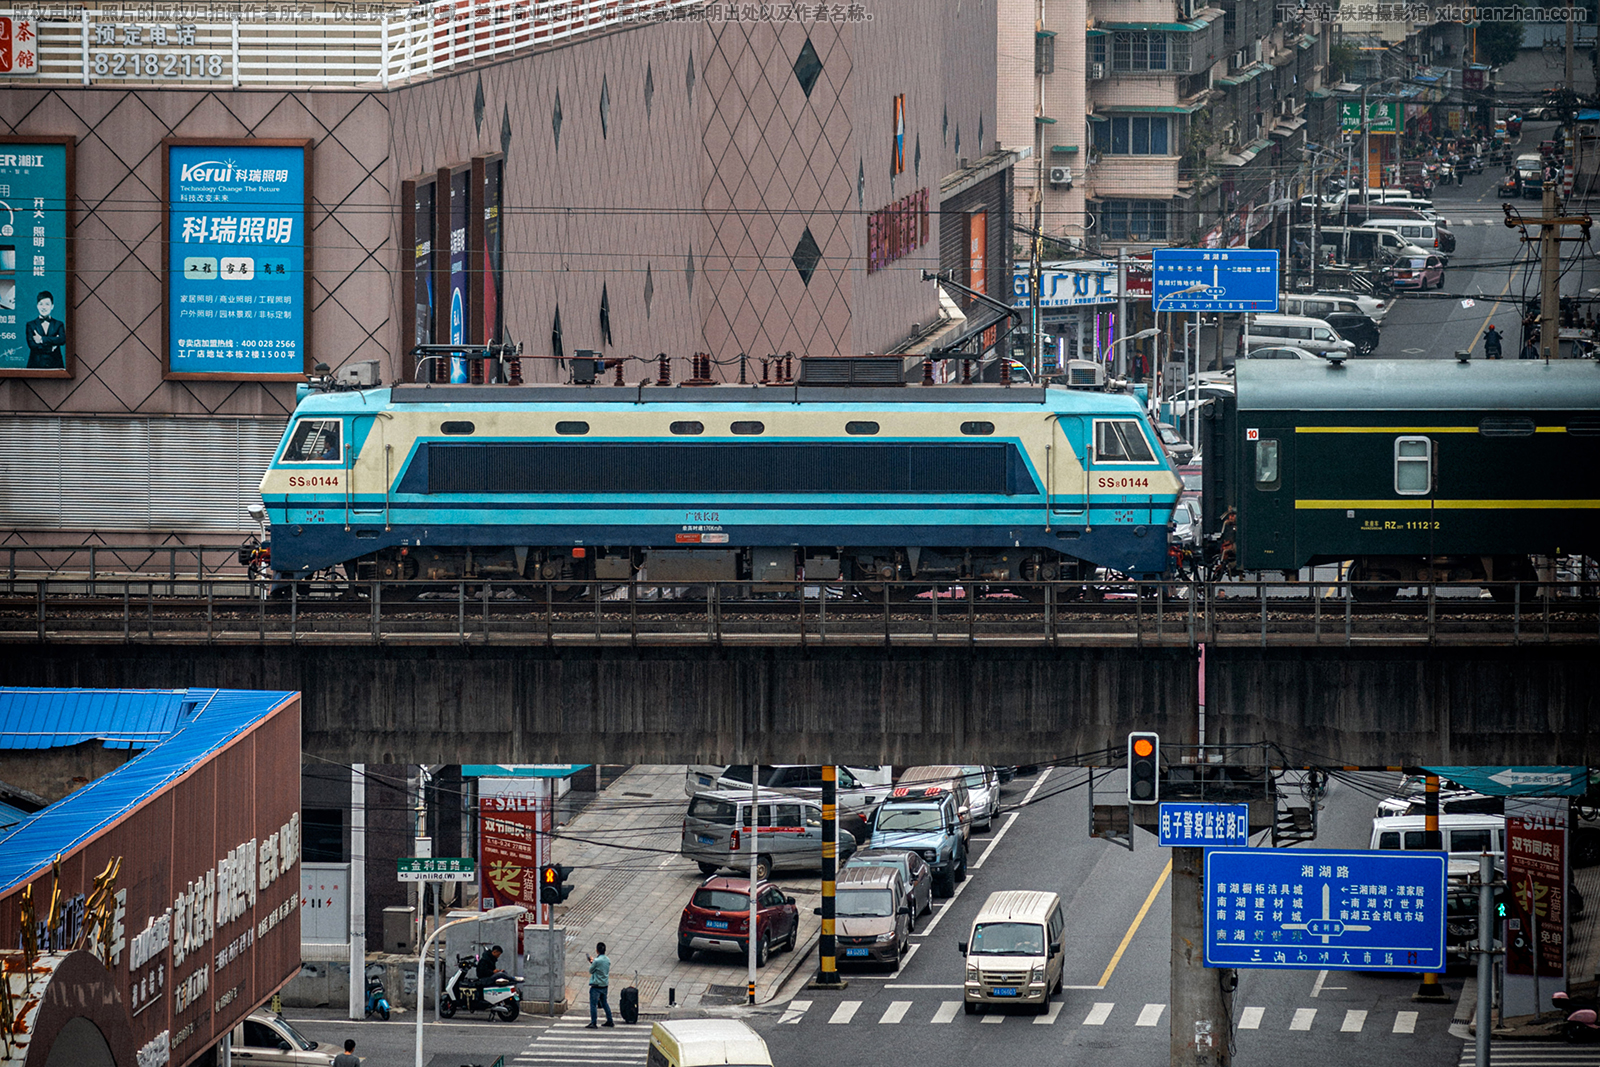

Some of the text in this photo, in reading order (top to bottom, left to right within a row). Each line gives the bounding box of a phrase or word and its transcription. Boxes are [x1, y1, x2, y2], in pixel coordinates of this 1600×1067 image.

[95, 24, 196, 46] 预定电话
[94, 53, 223, 76] 82182118
[235, 168, 288, 182] 科瑞照明
[180, 194, 229, 202] 科技改变未来
[182, 216, 293, 243] 科瑞照明
[1247, 430, 1258, 439] 10
[685, 512, 720, 521] 广铁长段
[496, 791, 536, 811] SALE
[485, 818, 525, 837] 双节同庆
[1162, 811, 1245, 839] 电子警察监控路口
[1523, 810, 1565, 831] SALE
[1512, 836, 1552, 857] 双节同庆
[411, 859, 460, 871] 金利西路
[1301, 865, 1350, 879] 湘湖路
[488, 860, 521, 896] 奖
[1217, 882, 1303, 896] 南湖橱柜洁具城
[1217, 897, 1303, 909] 南湖建材城
[1350, 898, 1424, 910] 南湖灯世界
[1515, 881, 1549, 916] 奖
[1216, 909, 1302, 922] 南湖石材城
[1340, 910, 1424, 922] 南湖五金机电市场
[1312, 923, 1341, 933] 金利路
[1540, 930, 1562, 945] 免单
